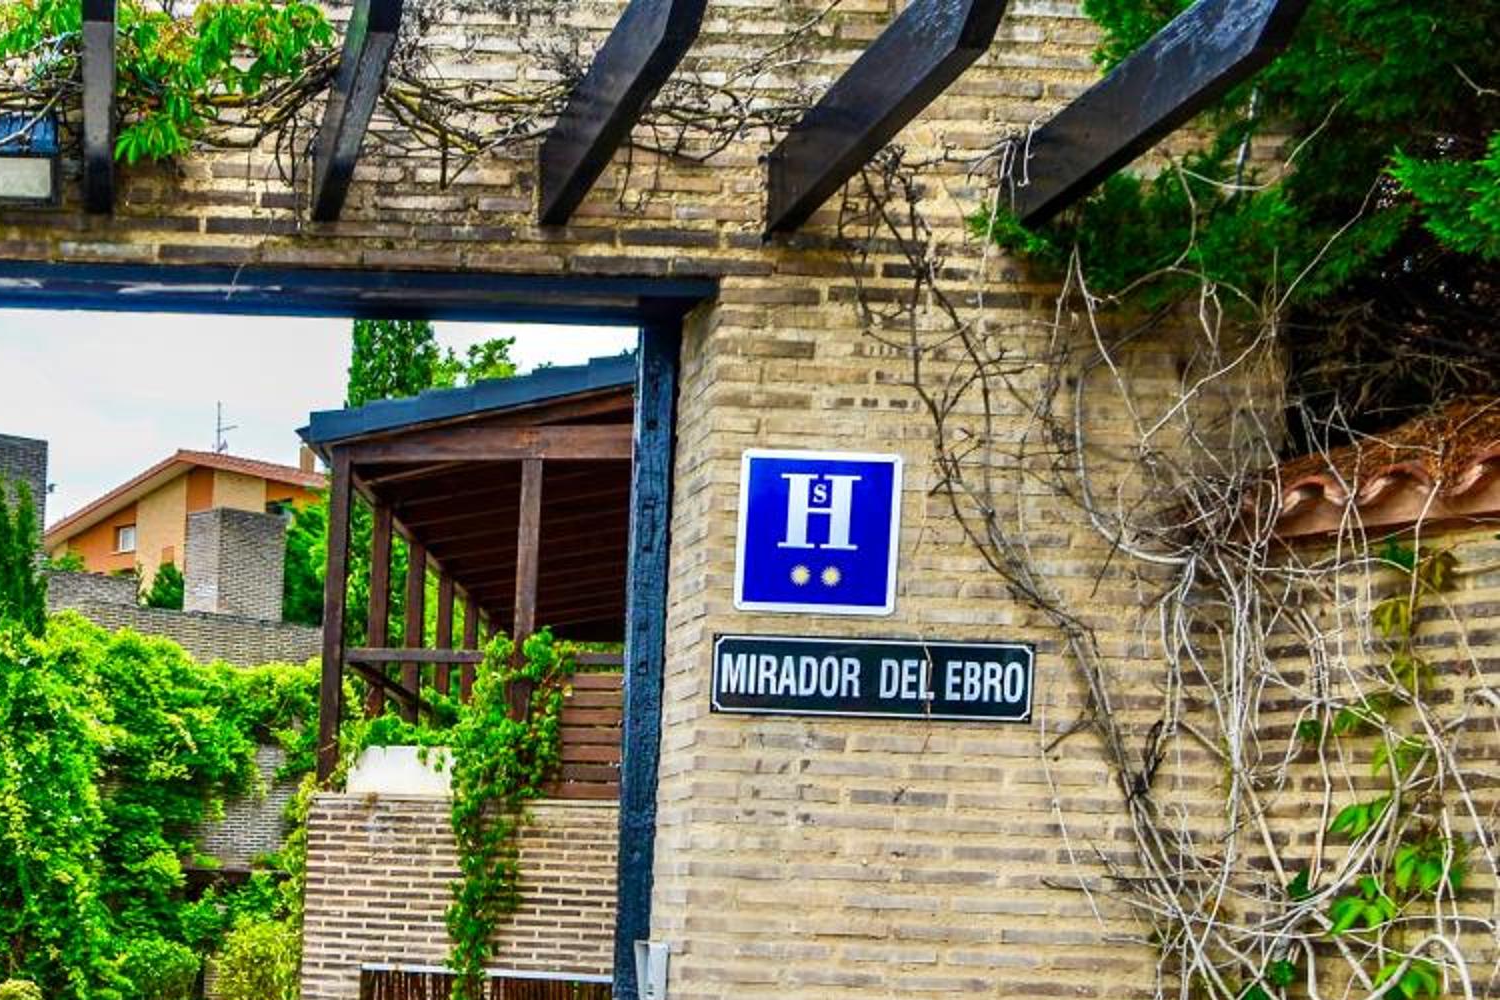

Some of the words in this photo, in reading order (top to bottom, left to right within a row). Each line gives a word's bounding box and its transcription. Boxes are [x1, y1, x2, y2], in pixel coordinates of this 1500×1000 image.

[777, 472, 862, 551] H
[720, 653, 861, 699] MIRADOR
[879, 658, 935, 701] DEL
[944, 661, 1024, 704] EBRO
